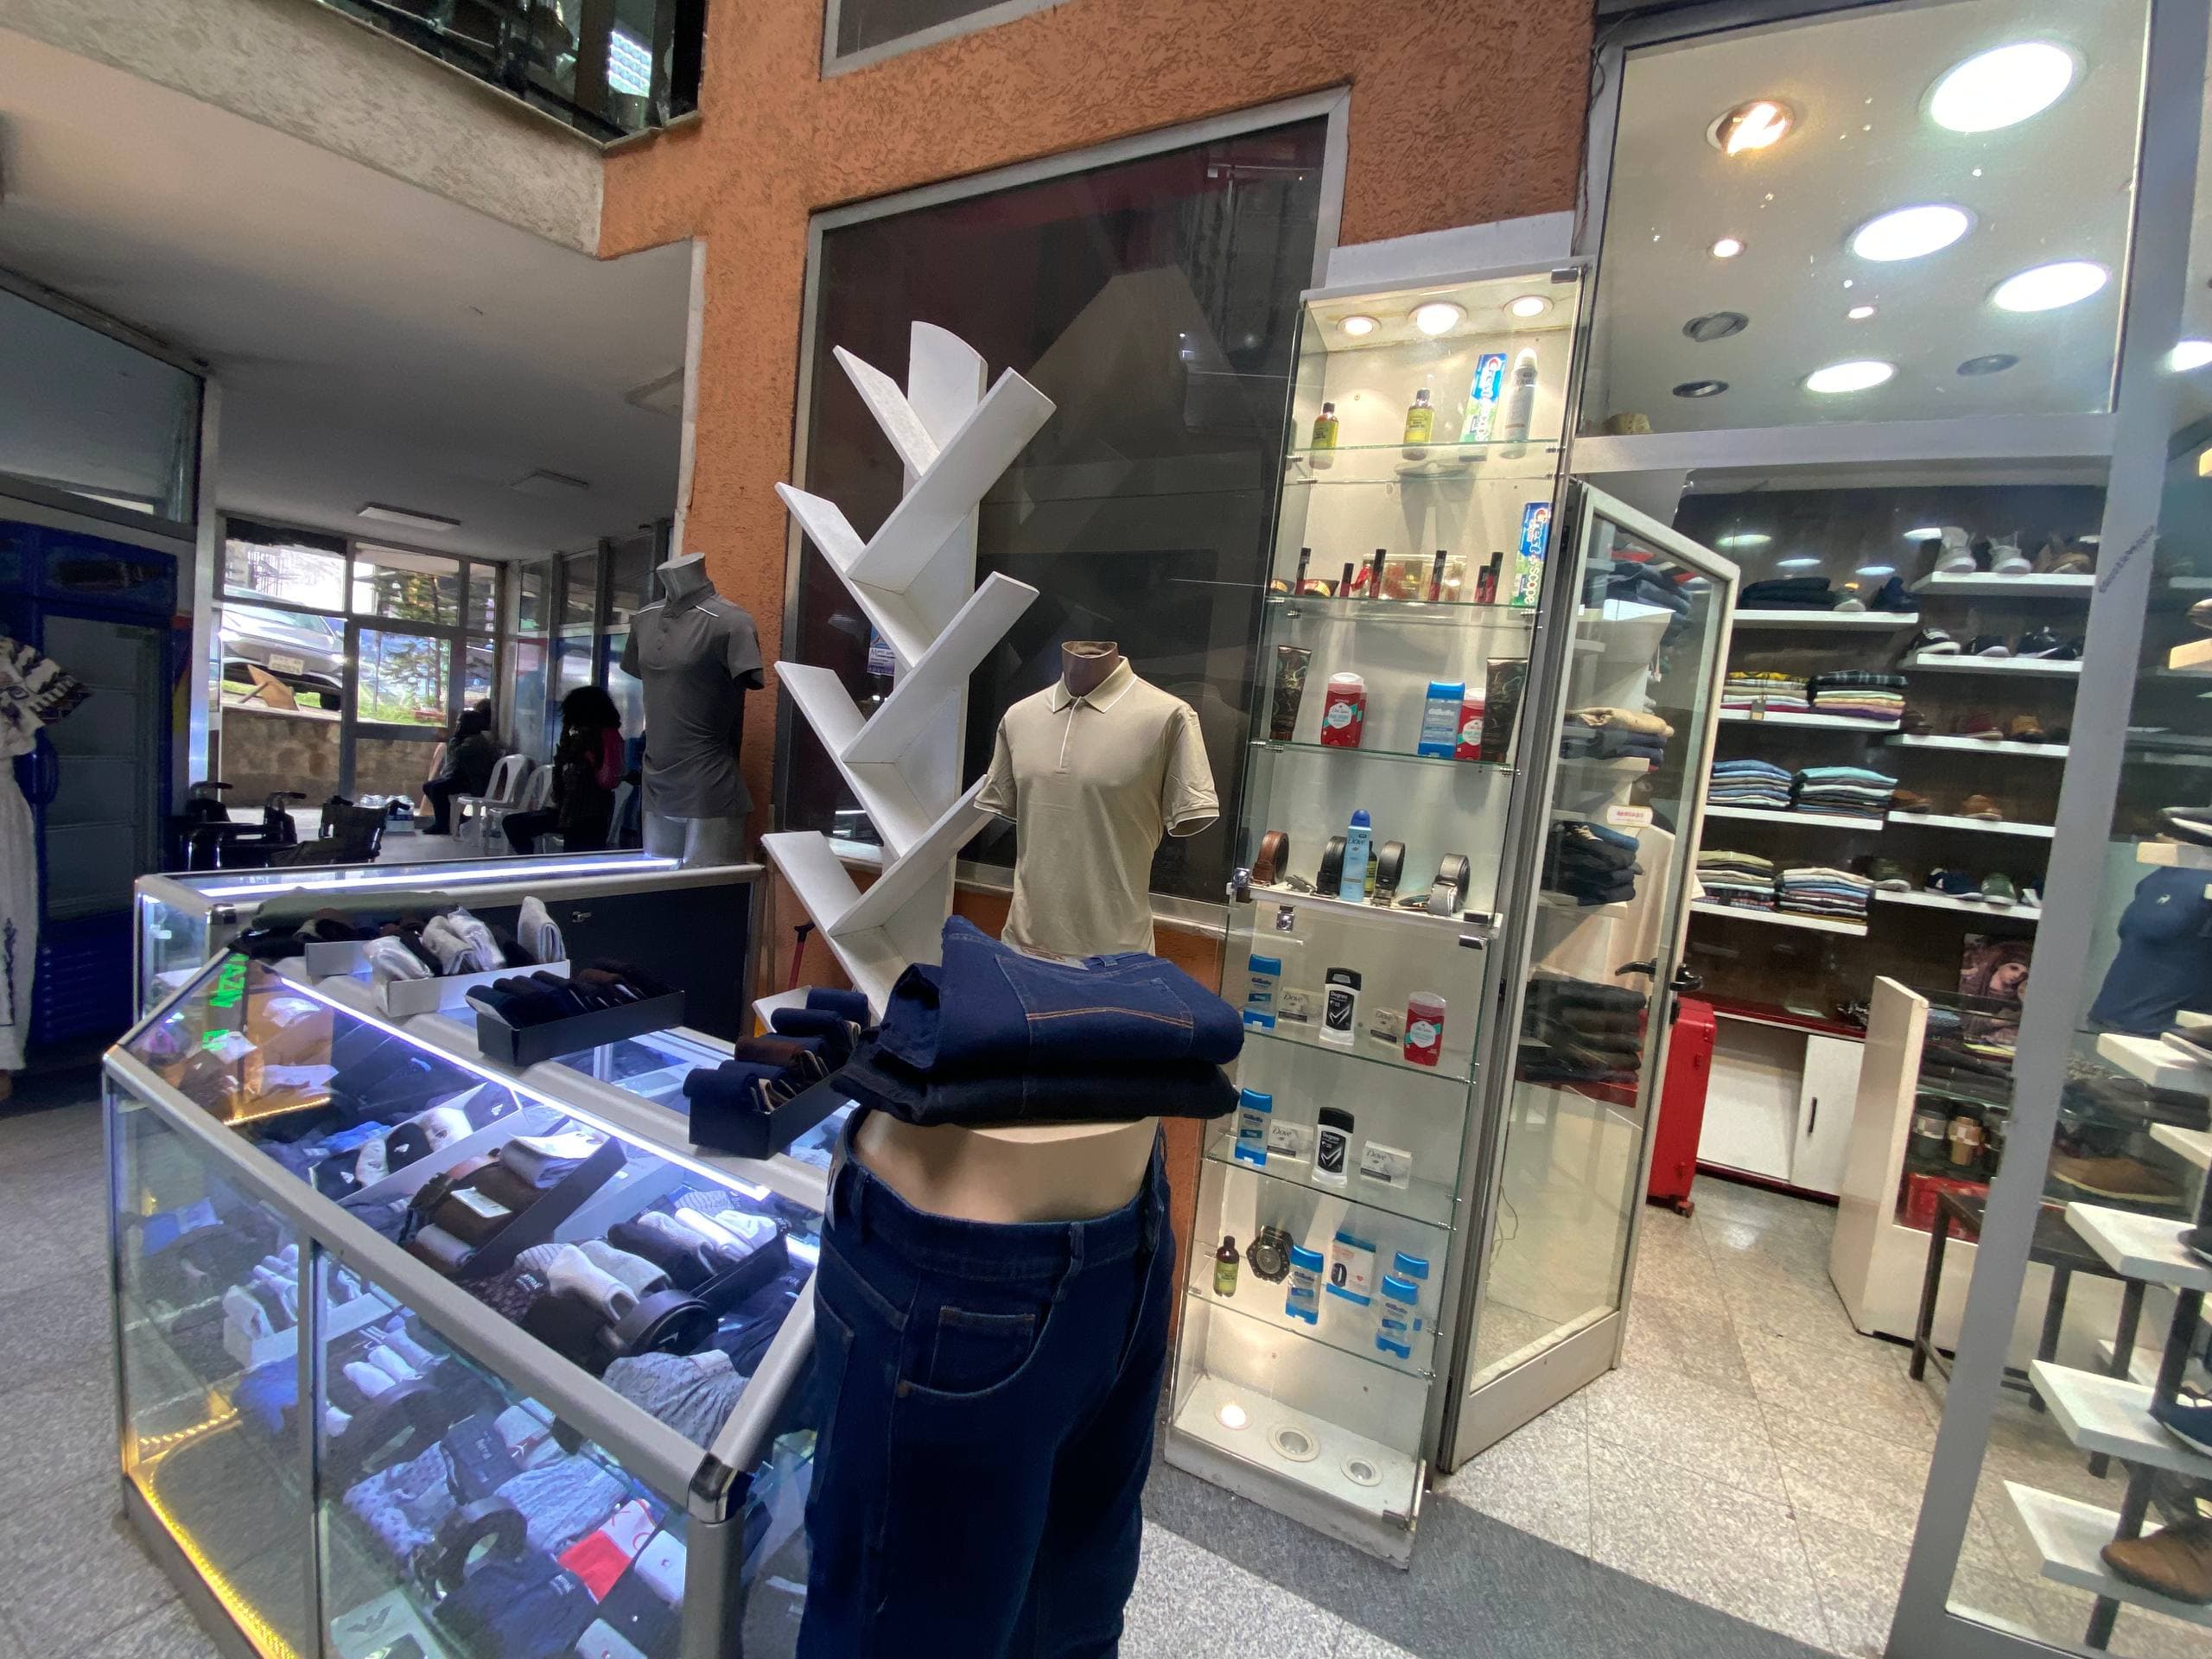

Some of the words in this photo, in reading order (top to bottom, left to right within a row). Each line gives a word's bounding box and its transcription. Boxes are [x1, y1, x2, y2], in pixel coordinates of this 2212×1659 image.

[1480, 357, 1500, 396] Crest
[1530, 508, 1548, 553] Crest
[1524, 567, 1539, 604] scope
[1284, 993, 1303, 1002] Dove
[1272, 1126, 1292, 1136] Dove
[1367, 1149, 1387, 1160] Dove
